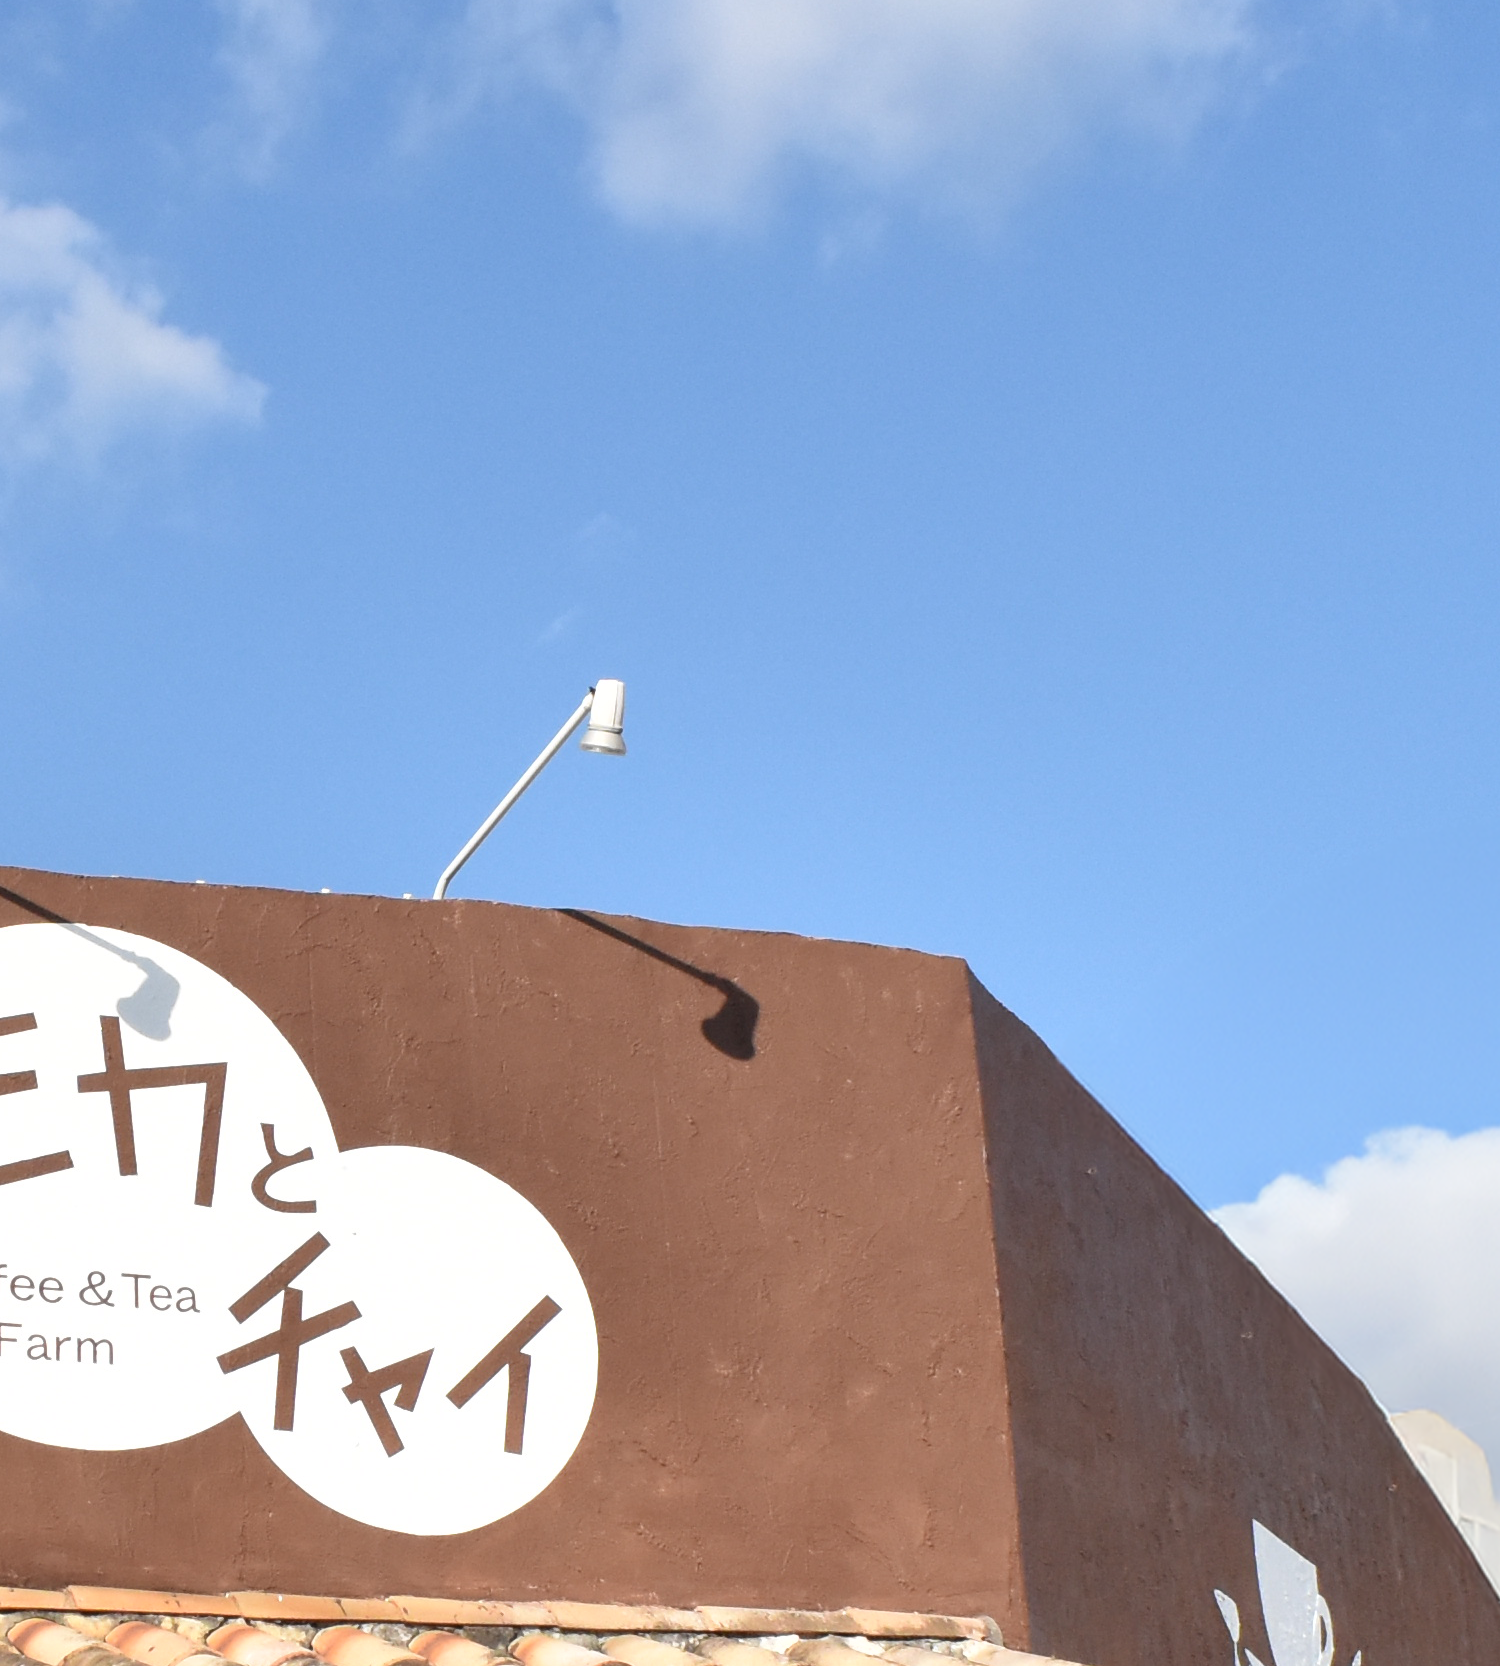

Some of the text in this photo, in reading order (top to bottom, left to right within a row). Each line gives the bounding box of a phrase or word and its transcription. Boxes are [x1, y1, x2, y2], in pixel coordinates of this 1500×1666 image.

[79, 1272, 115, 1308] &
[121, 1274, 200, 1313] Tea
[216, 1231, 562, 1458] チャイ
